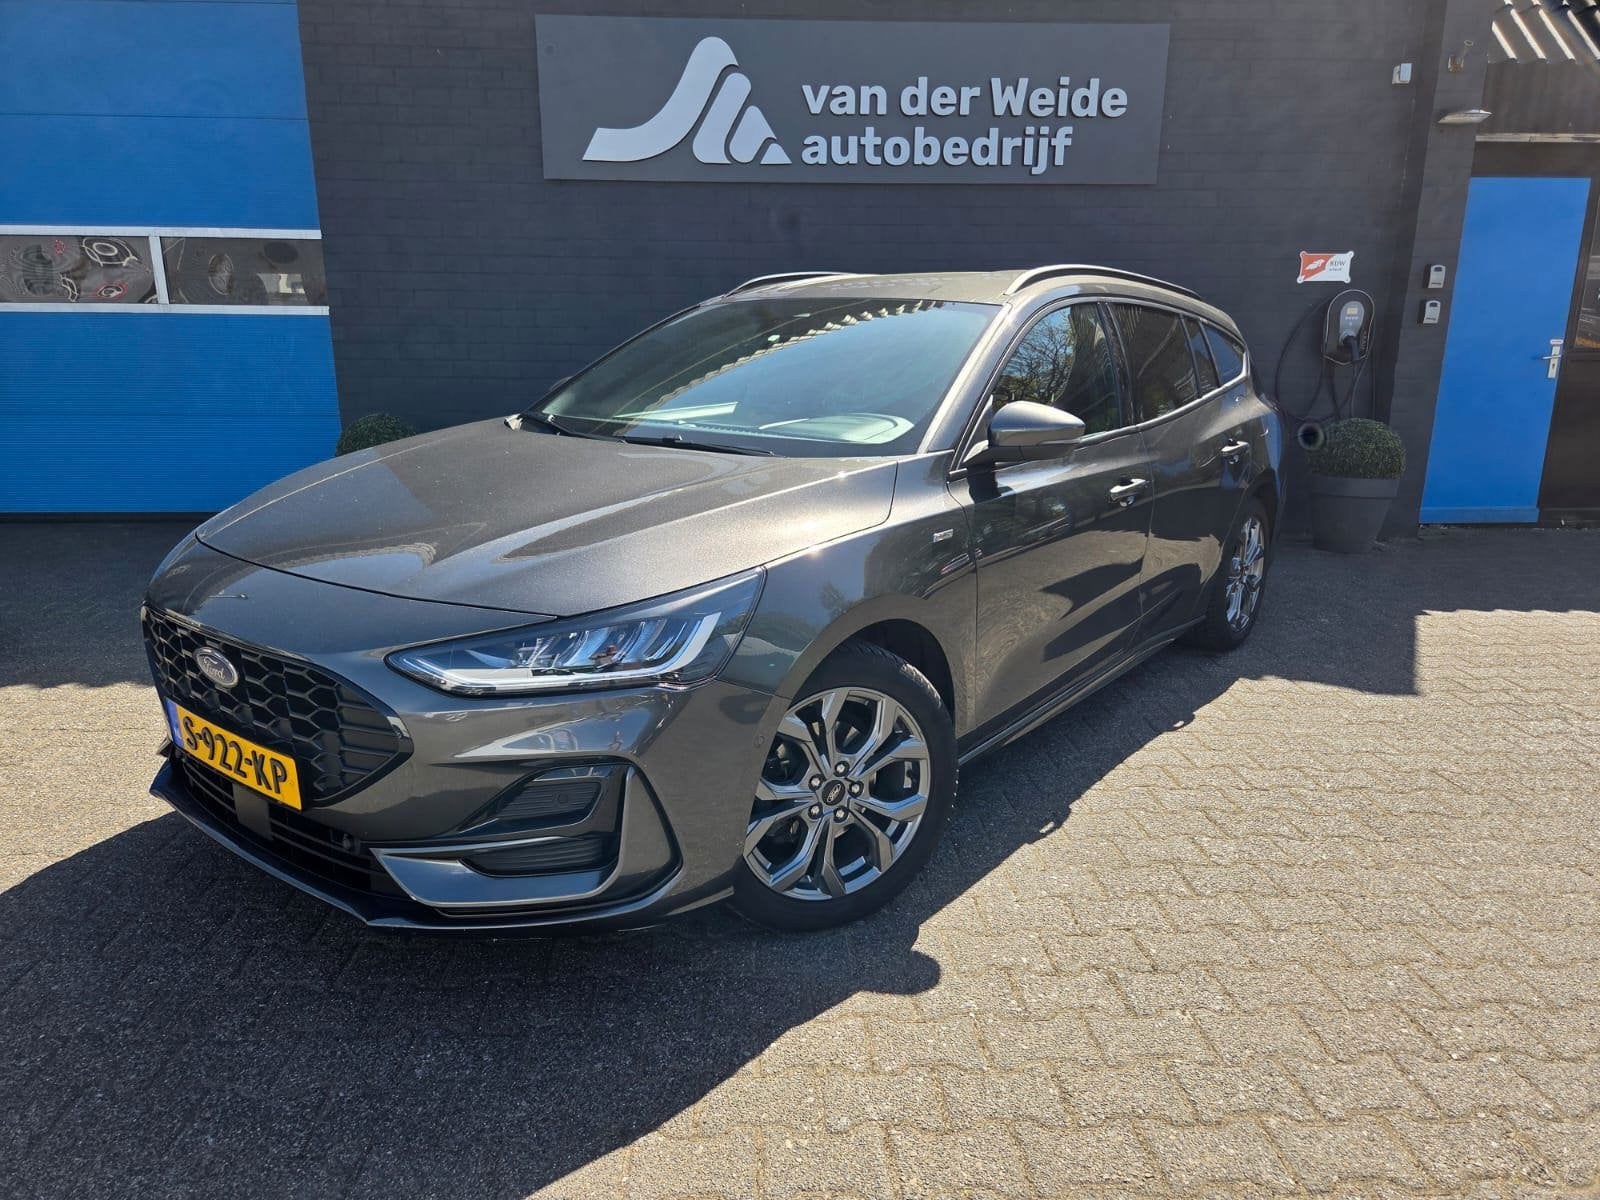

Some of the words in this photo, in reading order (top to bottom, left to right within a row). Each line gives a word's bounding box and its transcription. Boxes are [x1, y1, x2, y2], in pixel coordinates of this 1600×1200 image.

[802, 84, 888, 115] van
[900, 76, 981, 116] der
[990, 76, 1128, 118] Weide
[801, 126, 1074, 175] autobedrijf
[202, 655, 226, 681] Ford
[183, 715, 288, 795] S-922-KP
